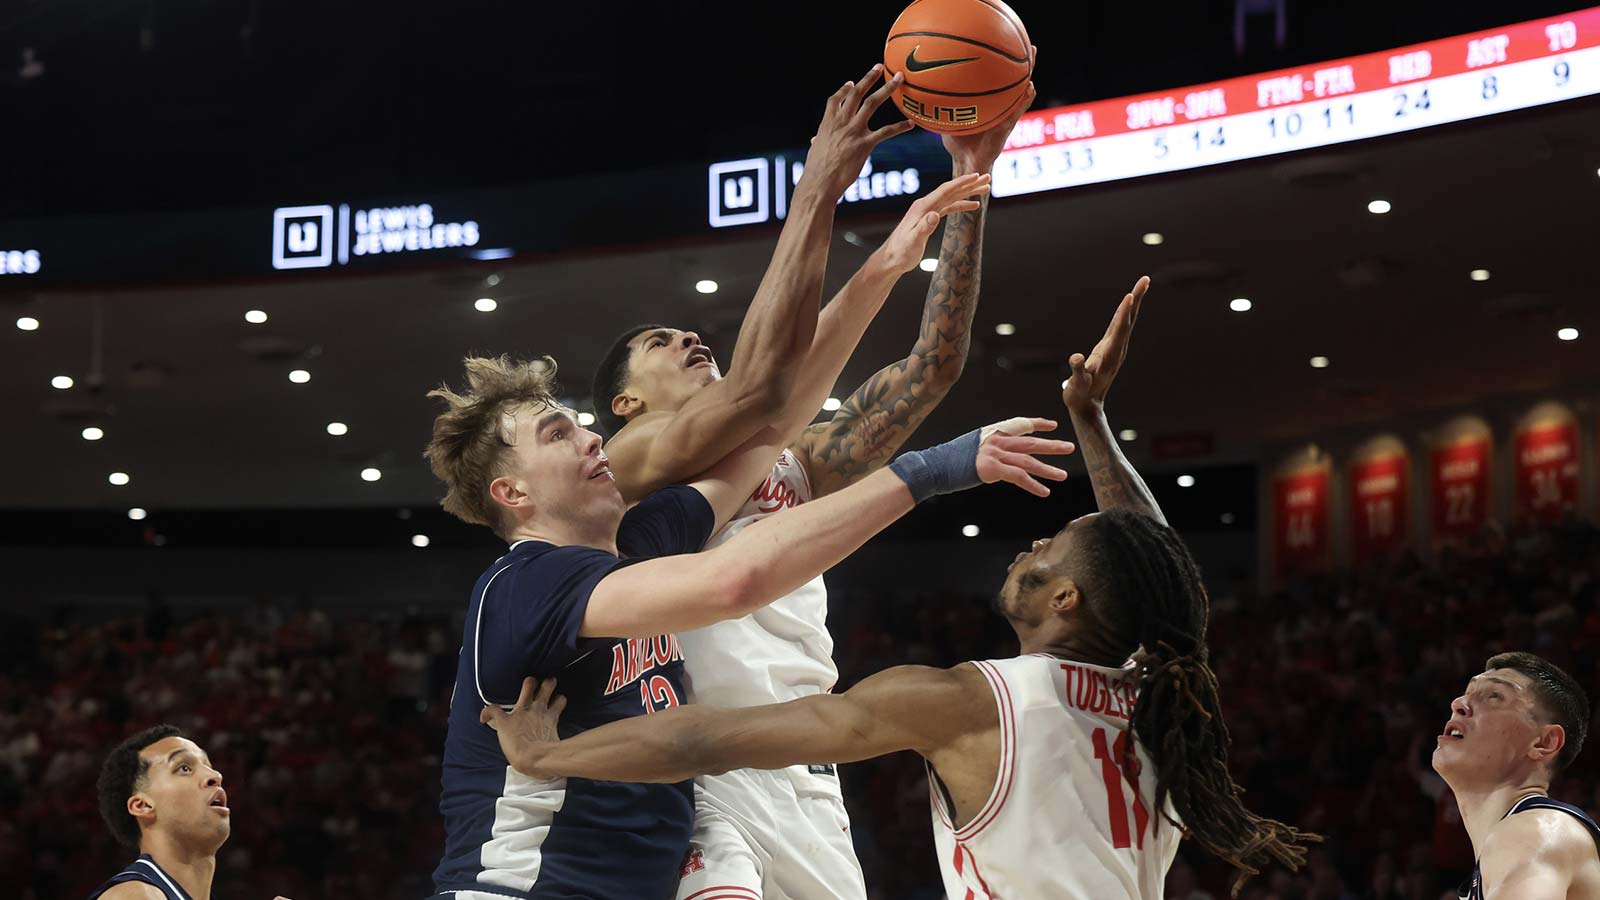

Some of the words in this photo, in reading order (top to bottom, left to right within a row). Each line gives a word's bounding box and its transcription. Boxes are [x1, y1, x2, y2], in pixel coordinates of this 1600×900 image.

[1388, 50, 1433, 83] REB
[1466, 33, 1510, 68] AST
[1545, 20, 1577, 52] TO
[902, 93, 977, 122] ELITE
[1010, 155, 1043, 181] 13
[1057, 147, 1094, 174] 33
[1154, 136, 1169, 159] 5
[1192, 126, 1226, 150] 14
[1267, 113, 1303, 138] 10
[1323, 103, 1354, 128] 11
[1392, 89, 1431, 118] 24
[1482, 75, 1498, 100] 8
[1553, 61, 1570, 87] 9
[355, 203, 434, 235] LEWIS
[352, 220, 480, 256] JEWELERS
